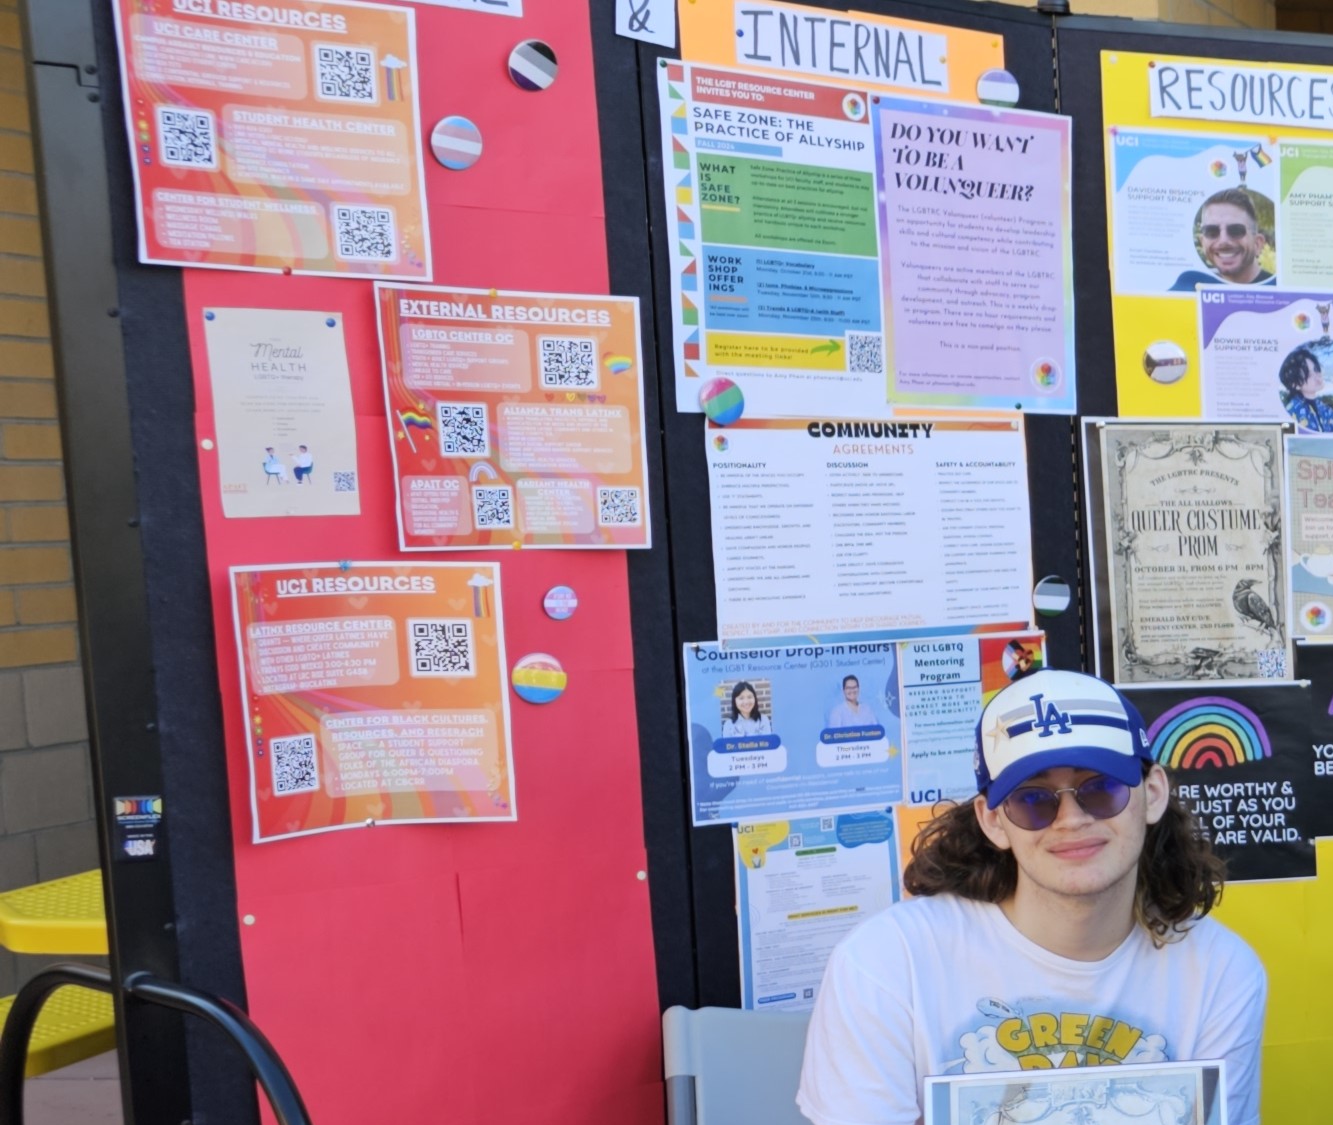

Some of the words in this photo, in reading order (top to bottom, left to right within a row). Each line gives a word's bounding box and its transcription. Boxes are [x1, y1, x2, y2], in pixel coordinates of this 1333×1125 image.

[173, 0, 212, 15] UCI
[218, 0, 346, 30] RESOURCES
[741, 11, 942, 86] INTERNAL
[696, 77, 713, 86] THE
[715, 79, 735, 89] LGBT
[738, 83, 781, 95] RESOURCE
[783, 89, 814, 100] CENTER
[697, 86, 729, 97] INVITES
[732, 90, 749, 100] YOU
[693, 107, 731, 122] SAFE
[738, 113, 782, 128] ZONE:
[787, 119, 814, 132] THE
[695, 121, 769, 140] PRACTICE
[775, 131, 794, 143] OF
[799, 134, 864, 151] ALLYSHIP
[891, 122, 921, 142] DO
[927, 126, 967, 146] YOU
[972, 130, 1034, 153] WANT
[893, 145, 920, 166] TO
[925, 151, 948, 169] BE
[952, 153, 963, 170] A
[700, 163, 735, 174] WHAT
[701, 173, 711, 182] IS
[701, 182, 730, 193] SAFE
[895, 173, 1034, 201] VOLUNQUEER?
[701, 193, 740, 204] ZONE?
[708, 255, 742, 265] WORK
[708, 265, 738, 274] SHOP
[709, 274, 744, 283] OFFER
[709, 284, 735, 292] INGS
[1203, 293, 1224, 303] UCI
[401, 300, 486, 318] EXTERNAL
[491, 305, 610, 323] RESOURCES
[807, 423, 933, 438] COMMUNITY
[833, 444, 914, 454] AGREEMENTS
[1132, 510, 1182, 534] QUEER
[1187, 508, 1261, 531] COSTUME
[1179, 535, 1218, 559] PROM
[277, 580, 307, 594] UCI
[314, 577, 435, 594] RESOURCES
[249, 625, 283, 637] LATINX
[287, 622, 341, 635] RESOURCE
[344, 619, 392, 631] CENTER
[914, 644, 930, 653] UCI
[933, 643, 963, 653] LGBTQ
[915, 657, 964, 667] Mentoring
[920, 671, 960, 683] Program
[1030, 694, 1072, 737] LA
[911, 789, 941, 803] UCI
[1204, 782, 1274, 797] WORTHY
[1282, 782, 1293, 795] &
[1192, 799, 1232, 814] JUST
[1237, 798, 1257, 812] AS
[1262, 797, 1295, 811] YOU
[1213, 815, 1234, 829] OF
[1240, 814, 1285, 828] YOUR
[1215, 830, 1246, 844] ARE
[1251, 828, 1300, 843] VALID.
[996, 1012, 1143, 1059] GREEN
